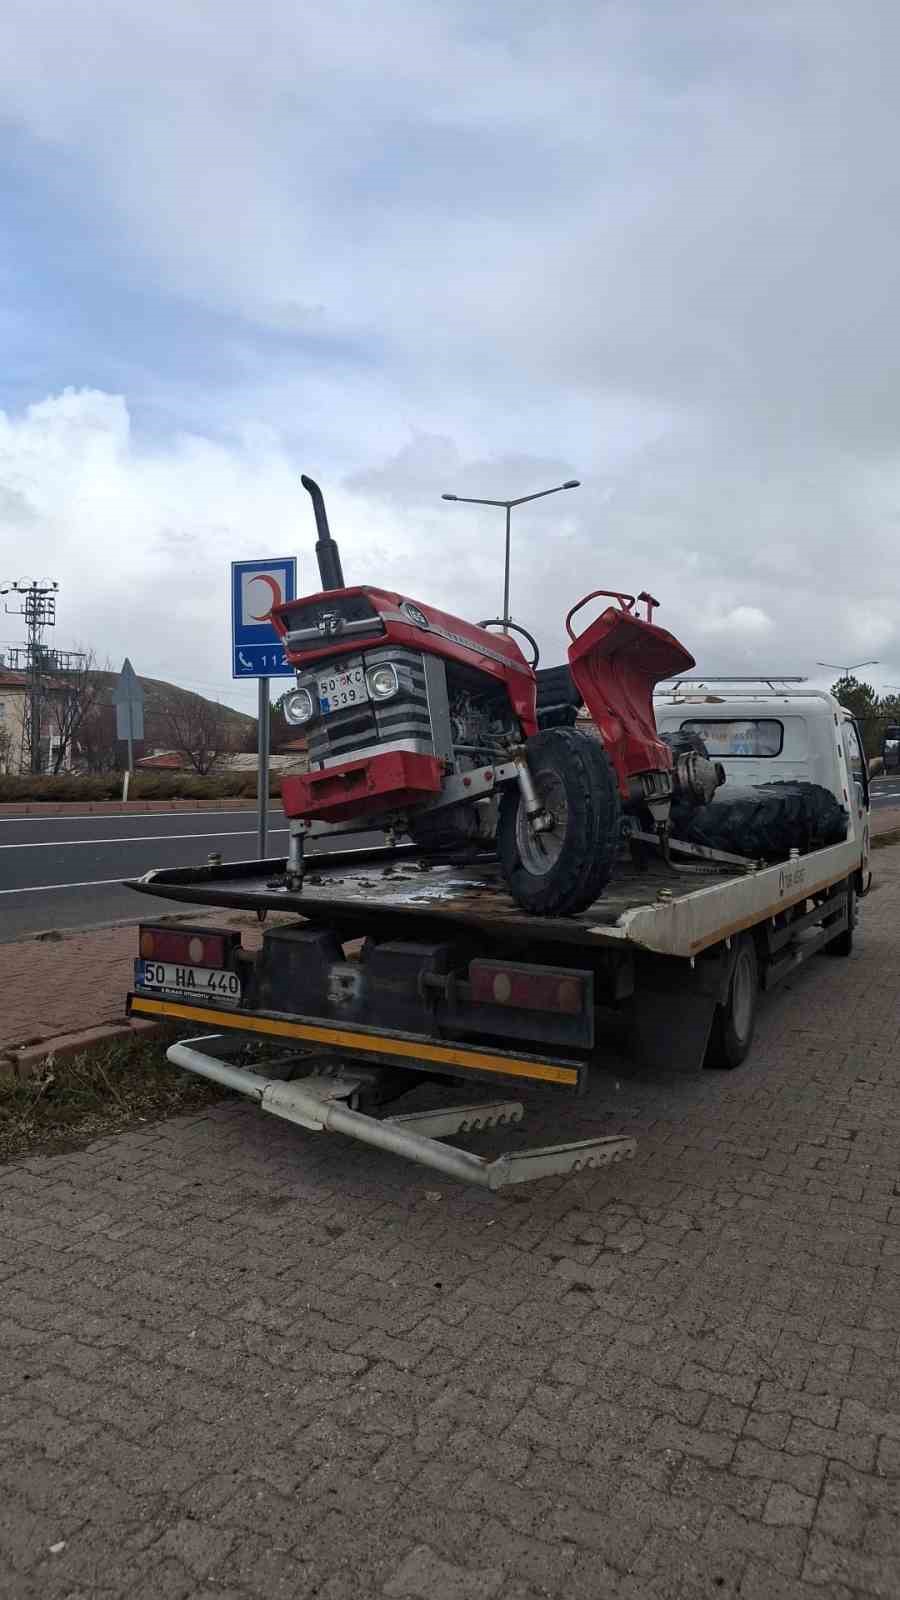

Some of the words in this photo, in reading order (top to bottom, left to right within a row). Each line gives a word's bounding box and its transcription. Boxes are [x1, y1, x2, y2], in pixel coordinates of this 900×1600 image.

[261, 654, 289, 667] 112
[320, 679, 336, 695] 50
[331, 689, 356, 706] 539
[144, 963, 165, 984] 50
[175, 967, 197, 988] HA
[207, 972, 239, 993] 440
